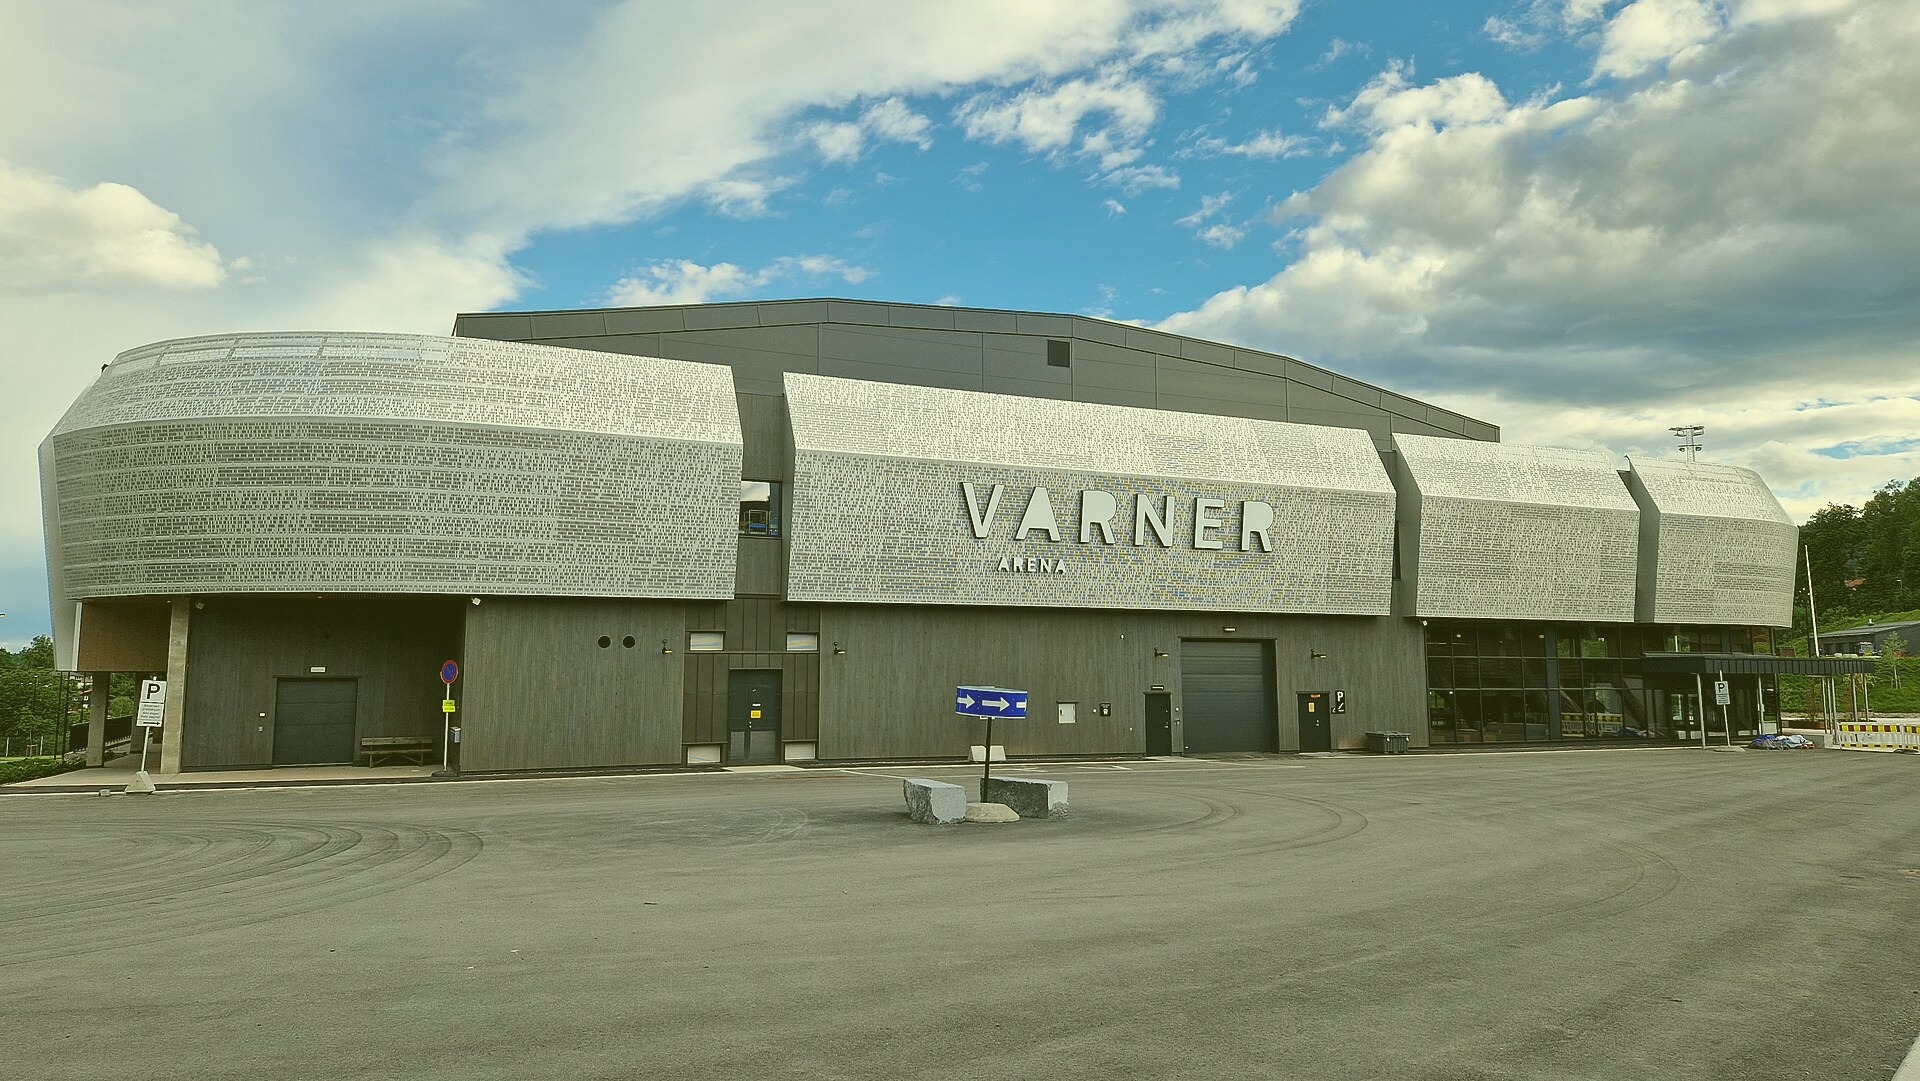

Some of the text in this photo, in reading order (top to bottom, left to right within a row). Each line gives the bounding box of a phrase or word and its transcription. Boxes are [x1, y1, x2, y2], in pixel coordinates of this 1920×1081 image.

[961, 482, 1275, 552] VARNER
[998, 557, 1066, 574] ARENA
[147, 683, 160, 699] P
[1718, 683, 1725, 693] P
[1337, 691, 1344, 702] P
